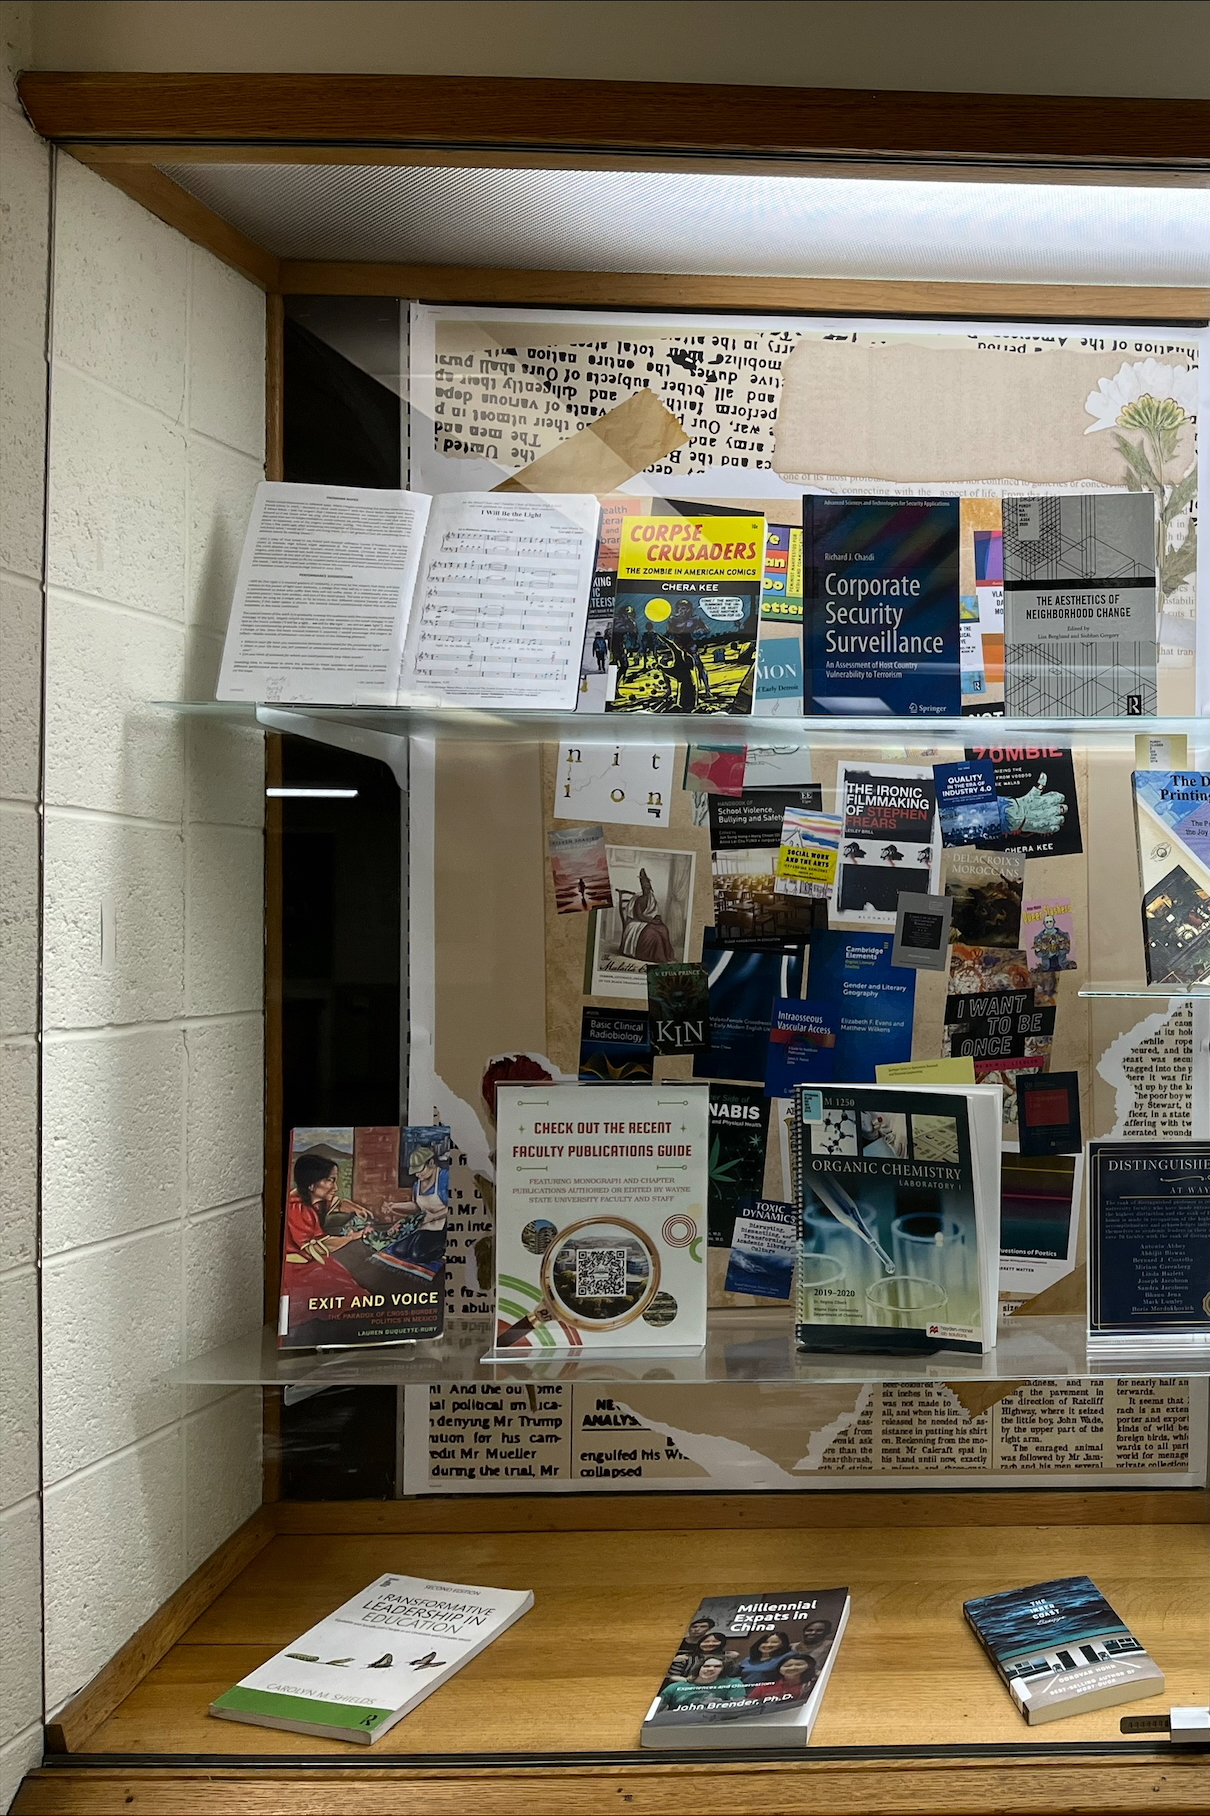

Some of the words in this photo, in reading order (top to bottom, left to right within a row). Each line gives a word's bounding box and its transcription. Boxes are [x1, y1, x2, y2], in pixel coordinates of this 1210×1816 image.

[630, 524, 704, 542] CORPSE
[647, 542, 757, 562] CRUSADERS
[825, 553, 847, 561] Richard
[854, 553, 875, 561] Chasdi
[684, 568, 724, 576] AMERICAN
[662, 583, 696, 591] CHERA
[699, 584, 719, 592] KEE
[825, 573, 921, 601] Corporate
[1036, 595, 1052, 606] THE
[1054, 595, 1105, 606] AESTHETICS
[1108, 594, 1120, 605] OF
[826, 602, 903, 629] Security
[1026, 608, 1094, 619] NEIGHBORHOOD
[1096, 607, 1131, 618] CHANGE
[826, 630, 944, 654] Surveillance
[826, 661, 833, 669] An
[835, 661, 870, 669] Assessment
[872, 661, 878, 669] of
[879, 661, 893, 669] Host
[894, 662, 918, 671] Country
[826, 670, 862, 679] Vulnerability
[864, 671, 872, 679] to
[873, 671, 902, 679] Terrorism
[919, 704, 947, 714] Springer
[948, 774, 983, 784] QUALITY
[1170, 775, 1197, 787] The
[848, 783, 874, 795] THE
[877, 785, 922, 798] IRONIC
[942, 787, 978, 797] INDUSTRY
[847, 794, 929, 810] FILMMAKING
[846, 805, 863, 816] OF
[867, 807, 927, 820] STEPHEN
[719, 815, 747, 824] Bullying
[846, 817, 897, 829] FREARS
[952, 865, 1019, 877] MOROCCANS
[843, 982, 865, 990] Gender
[882, 984, 907, 993] Literary
[843, 989, 879, 998] Geography
[957, 1000, 964, 1018] I
[969, 995, 1027, 1017] WANT
[778, 1011, 823, 1024] Intraosseous
[591, 1020, 611, 1029] Basic
[614, 1021, 644, 1032] Clinical
[777, 1021, 806, 1033] Vascular
[808, 1024, 831, 1035] Access
[987, 1017, 1014, 1036] TO
[1018, 1013, 1043, 1033] BE
[590, 1029, 643, 1043] Radiobiology
[656, 1020, 704, 1047] KIN
[961, 1036, 1013, 1057] ONCE
[534, 1122, 573, 1134] CHECK
[578, 1122, 601, 1133] OUT
[604, 1122, 625, 1133] THE
[629, 1122, 672, 1133] RECENT
[513, 1146, 564, 1157] FACULTY
[568, 1145, 653, 1157] PUBLICATIONS
[658, 1145, 692, 1156] GUIDE
[811, 1160, 878, 1174] ORGANIC
[882, 1164, 961, 1180] CHEMISTRY
[755, 1202, 786, 1214] TOXIC
[309, 1297, 345, 1310] EXIT
[351, 1295, 385, 1308] AND
[391, 1292, 438, 1306] VOICE
[580, 1465, 642, 1479] collapsed
[363, 1600, 464, 1623] LEADERSHIP
[737, 1600, 817, 1613] Millennial
[361, 1612, 464, 1634] EDUCATION
[734, 1612, 790, 1624] Expats
[793, 1611, 808, 1620] in
[730, 1622, 776, 1632] China
[673, 1703, 704, 1712] John
[707, 1697, 760, 1710] Brender,
